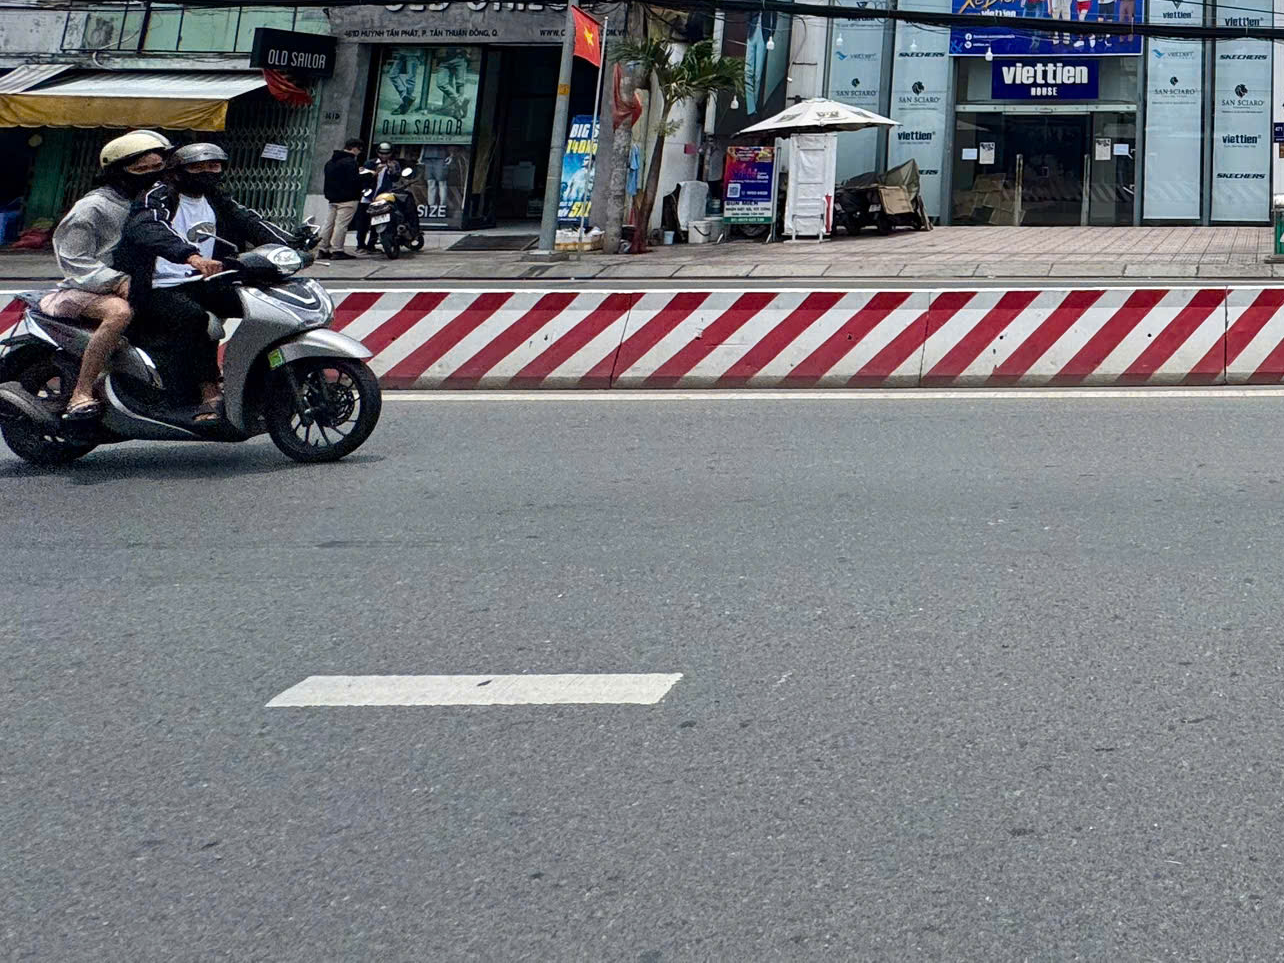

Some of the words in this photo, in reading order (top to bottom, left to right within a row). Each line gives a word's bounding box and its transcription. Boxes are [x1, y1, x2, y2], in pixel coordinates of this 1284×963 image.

[268, 49, 288, 65] OLD
[291, 52, 326, 69] SAILOR
[1002, 63, 1088, 84] viettien
[1031, 88, 1057, 96] HOUSE
[383, 119, 406, 134] OLD
[414, 119, 463, 135] SAILOR
[570, 124, 590, 138] BIG
[898, 131, 932, 140] viettien
[1222, 135, 1257, 144] viettien
[417, 205, 446, 217] SIZE
